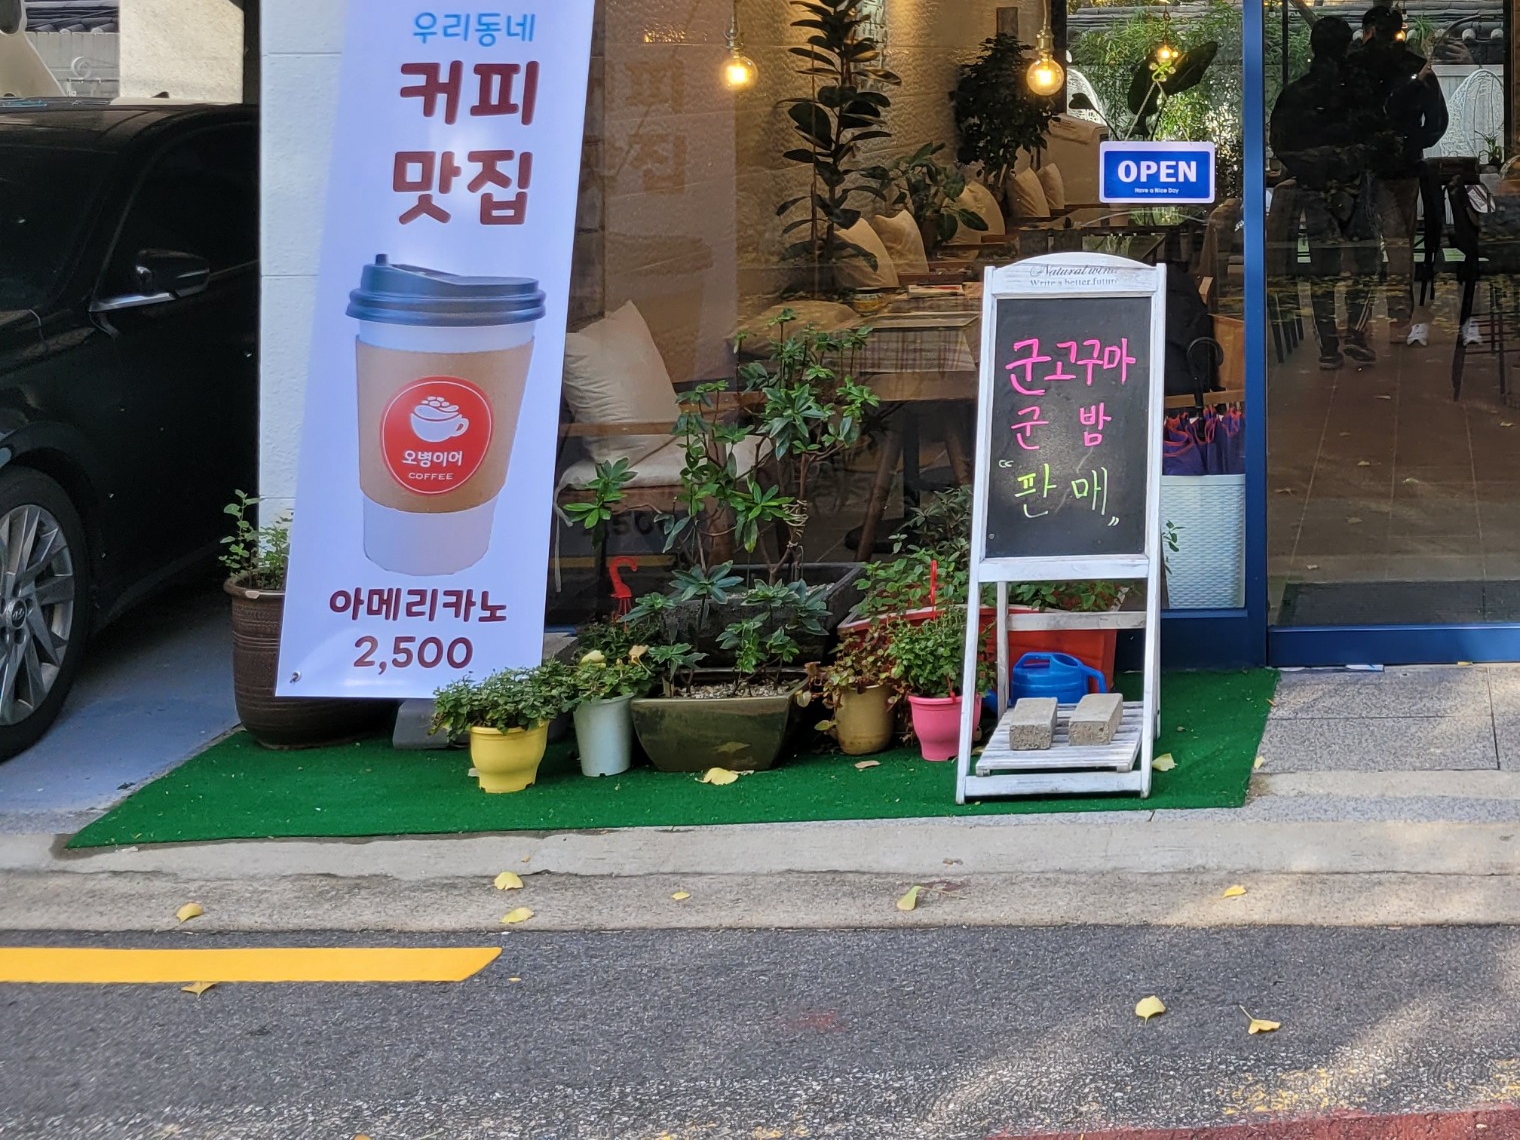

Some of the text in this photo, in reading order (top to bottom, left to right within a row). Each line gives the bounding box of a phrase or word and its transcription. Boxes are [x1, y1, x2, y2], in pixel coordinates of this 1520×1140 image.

[412, 12, 537, 47] 우리동네
[400, 60, 540, 125] 커피
[392, 149, 534, 226] 맛집
[1117, 160, 1197, 183] OPEN
[1168, 187, 1179, 195] Day
[1030, 263, 1088, 278] Natural
[1005, 337, 1136, 395] 군고구마
[402, 450, 463, 468] 오병이어
[408, 472, 454, 480] COFFEE
[329, 587, 507, 623] 아메리카노
[353, 635, 474, 675] 2,500
